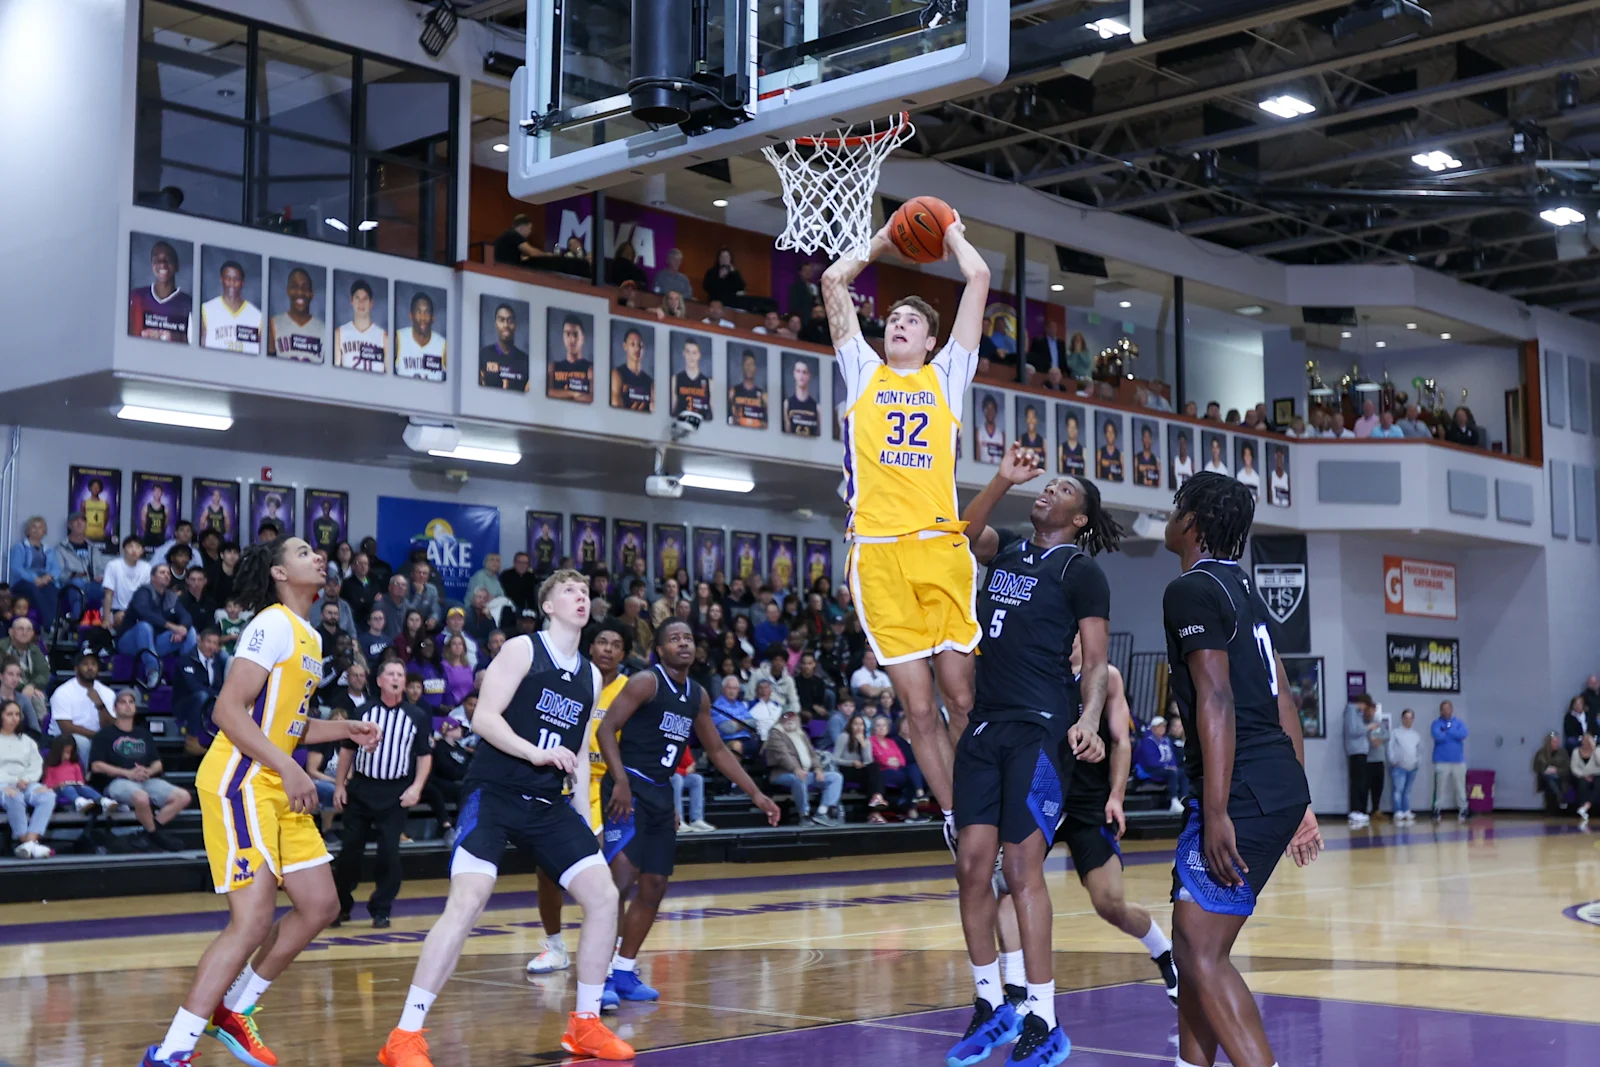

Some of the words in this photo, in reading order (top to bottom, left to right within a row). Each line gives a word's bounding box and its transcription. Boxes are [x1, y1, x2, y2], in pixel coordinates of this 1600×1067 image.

[886, 411, 929, 447] 32
[879, 450, 933, 469] ACADEMY
[427, 540, 472, 568] AKE
[988, 569, 1038, 601] DME
[1268, 588, 1294, 607] HS
[1385, 567, 1402, 604] G
[990, 594, 1021, 606] ACADEMY
[989, 609, 1007, 638] 5
[1419, 661, 1452, 690] WINS
[535, 688, 583, 725] DME
[540, 713, 571, 730] ACADEMY
[659, 711, 692, 738] DME
[538, 728, 562, 750] 10
[661, 744, 678, 768] 3
